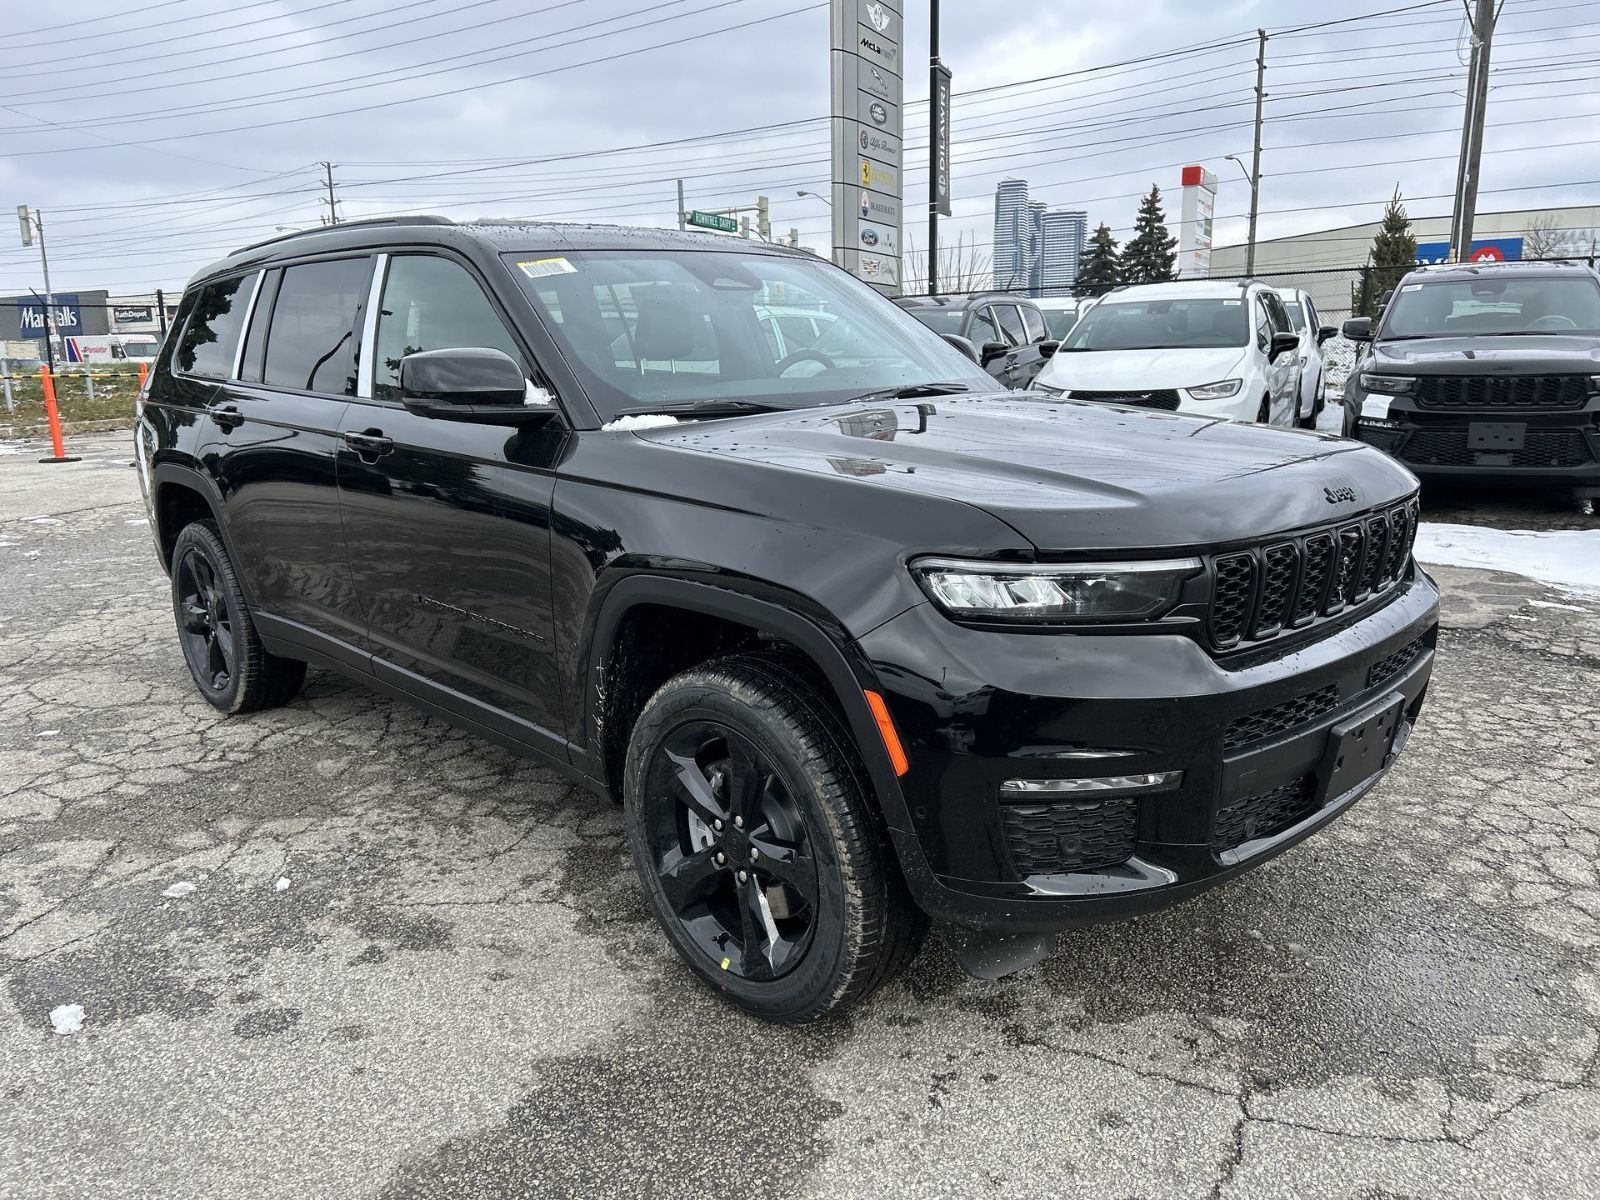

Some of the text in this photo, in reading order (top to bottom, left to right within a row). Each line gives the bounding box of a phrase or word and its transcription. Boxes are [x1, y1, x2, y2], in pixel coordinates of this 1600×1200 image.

[870, 201, 896, 216] MASERATI
[20, 306, 77, 329] Maralls
[1323, 486, 1357, 504] Jeep
